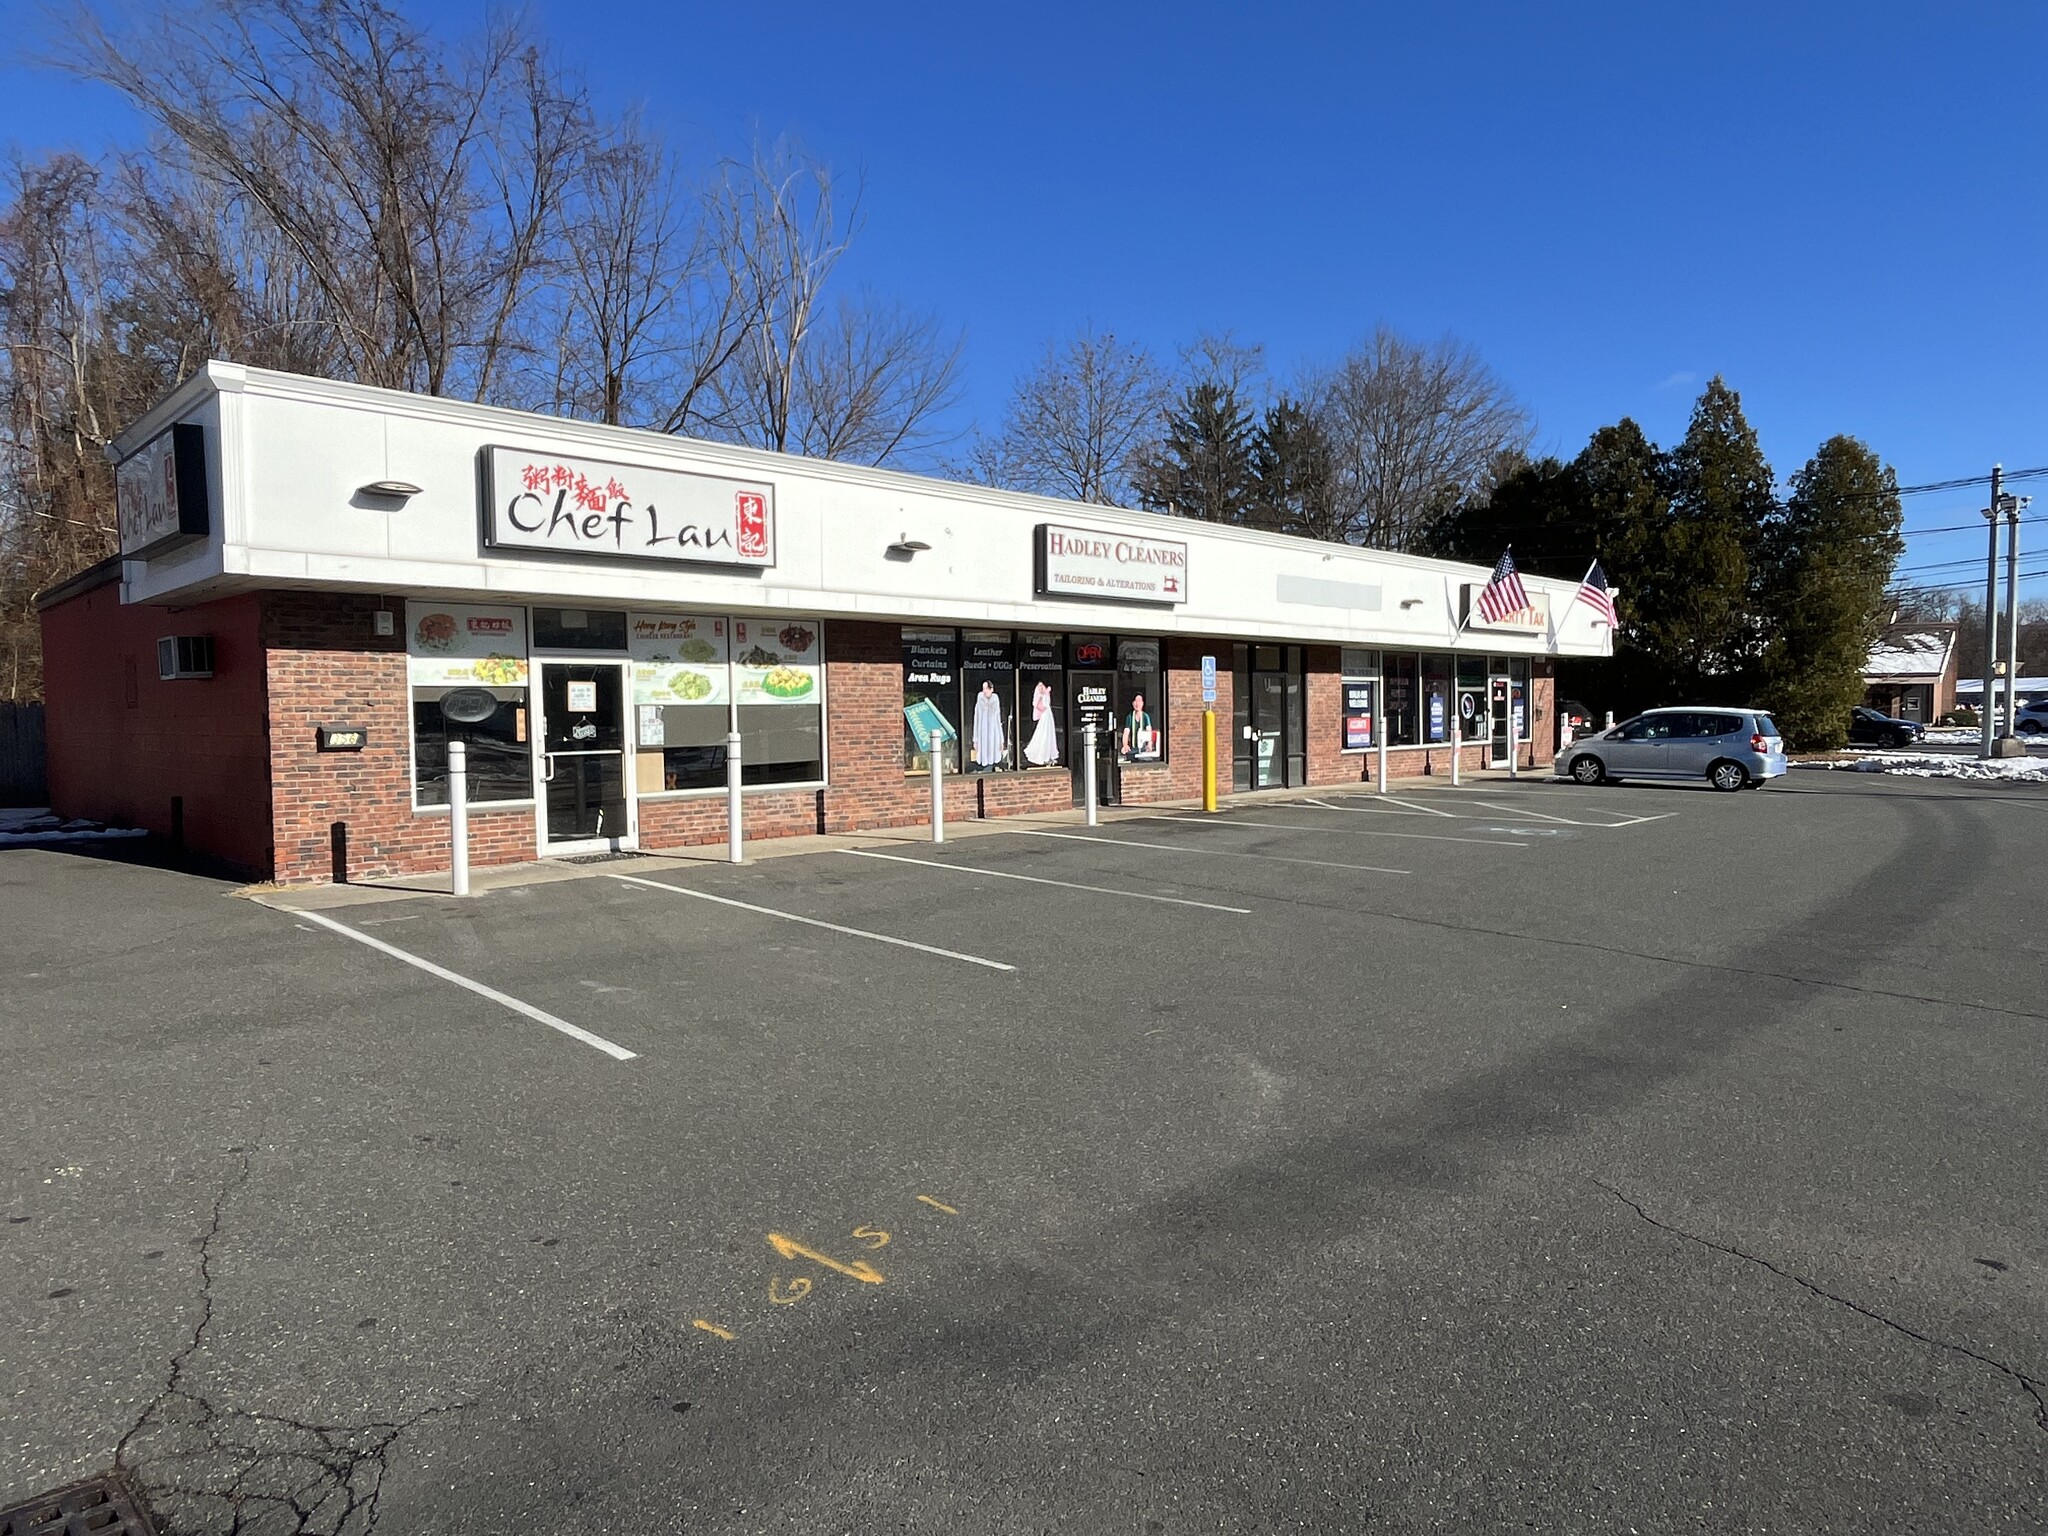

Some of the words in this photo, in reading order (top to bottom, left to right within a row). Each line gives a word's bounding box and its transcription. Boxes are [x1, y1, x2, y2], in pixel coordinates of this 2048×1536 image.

[508, 489, 633, 549] Chef
[646, 504, 732, 548] Lau
[1054, 573, 1095, 586] TAILORING
[1097, 578, 1104, 587] &
[1106, 579, 1156, 591] ALTERATIONS
[910, 645, 948, 655] Blankets
[973, 648, 1003, 656] Leather
[911, 659, 948, 668] Curtains
[908, 672, 930, 683] Area
[930, 672, 952, 685] Rugs
